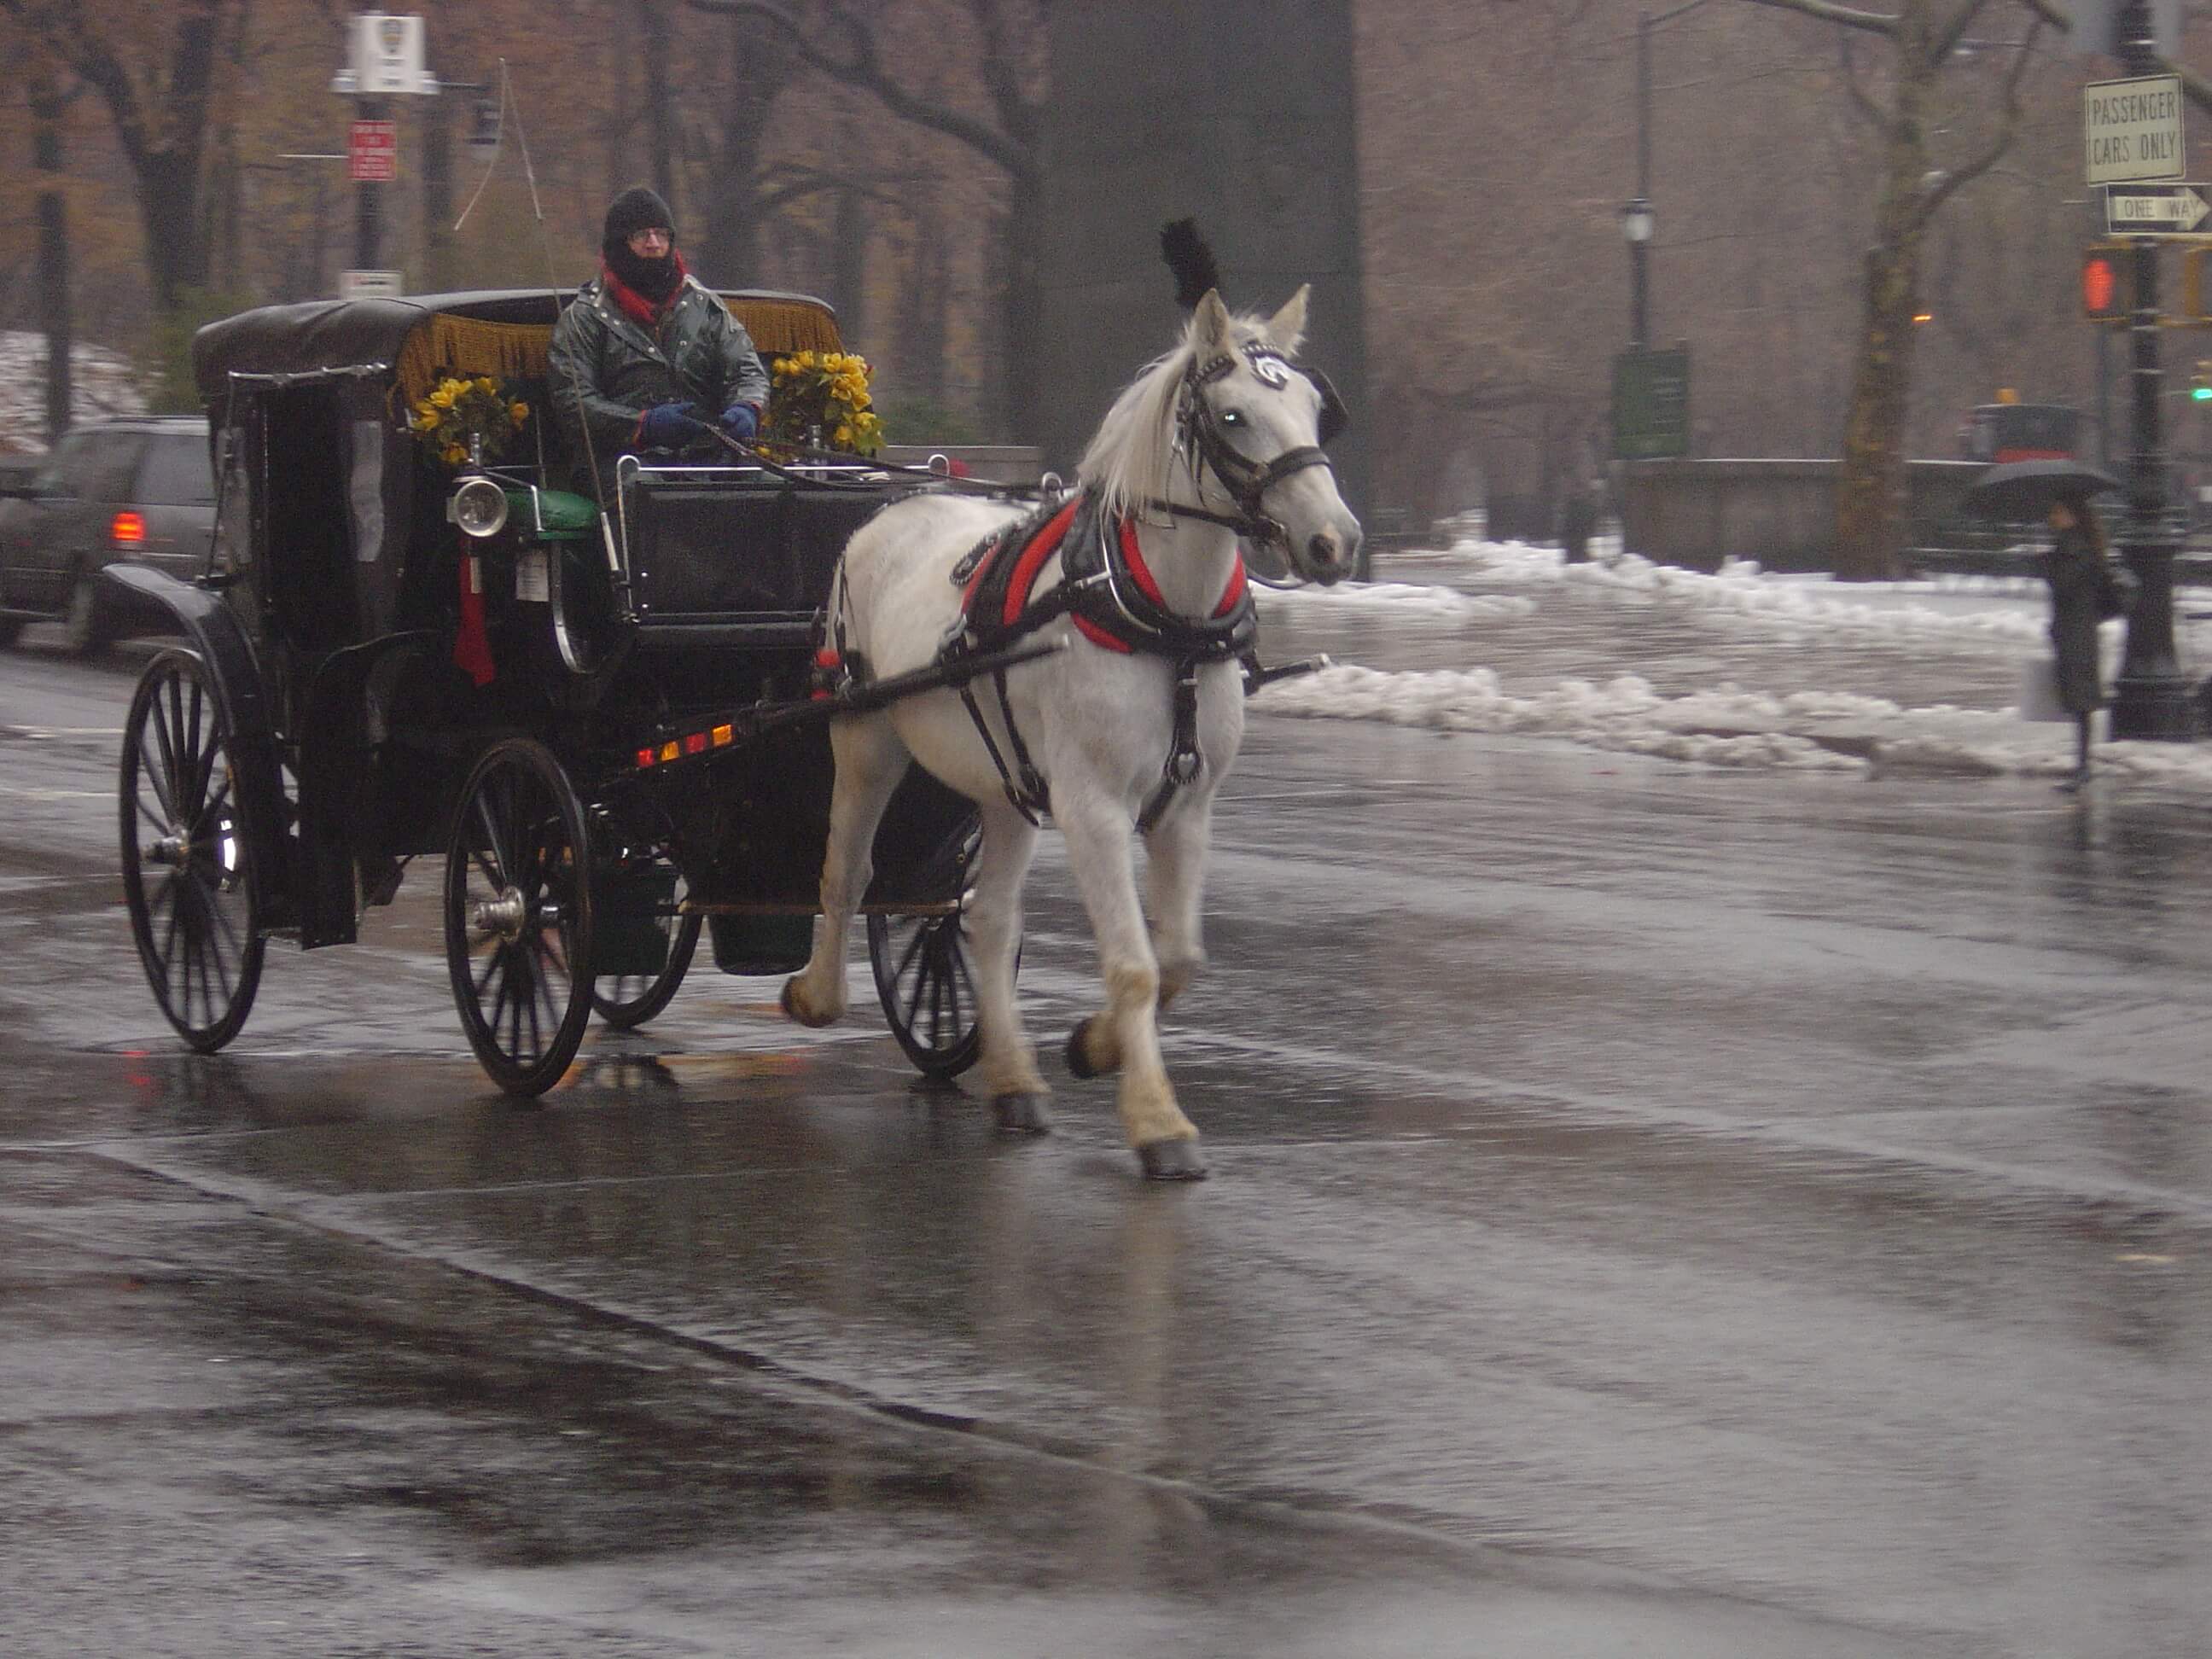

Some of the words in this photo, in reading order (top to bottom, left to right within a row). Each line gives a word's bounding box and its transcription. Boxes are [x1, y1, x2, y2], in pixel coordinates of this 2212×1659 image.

[2093, 92, 2175, 125] PASSENGER
[2093, 136, 2131, 166] CARS
[2140, 131, 2176, 160] ONLY
[2124, 198, 2155, 218] ONE
[2169, 198, 2201, 218] WAY
